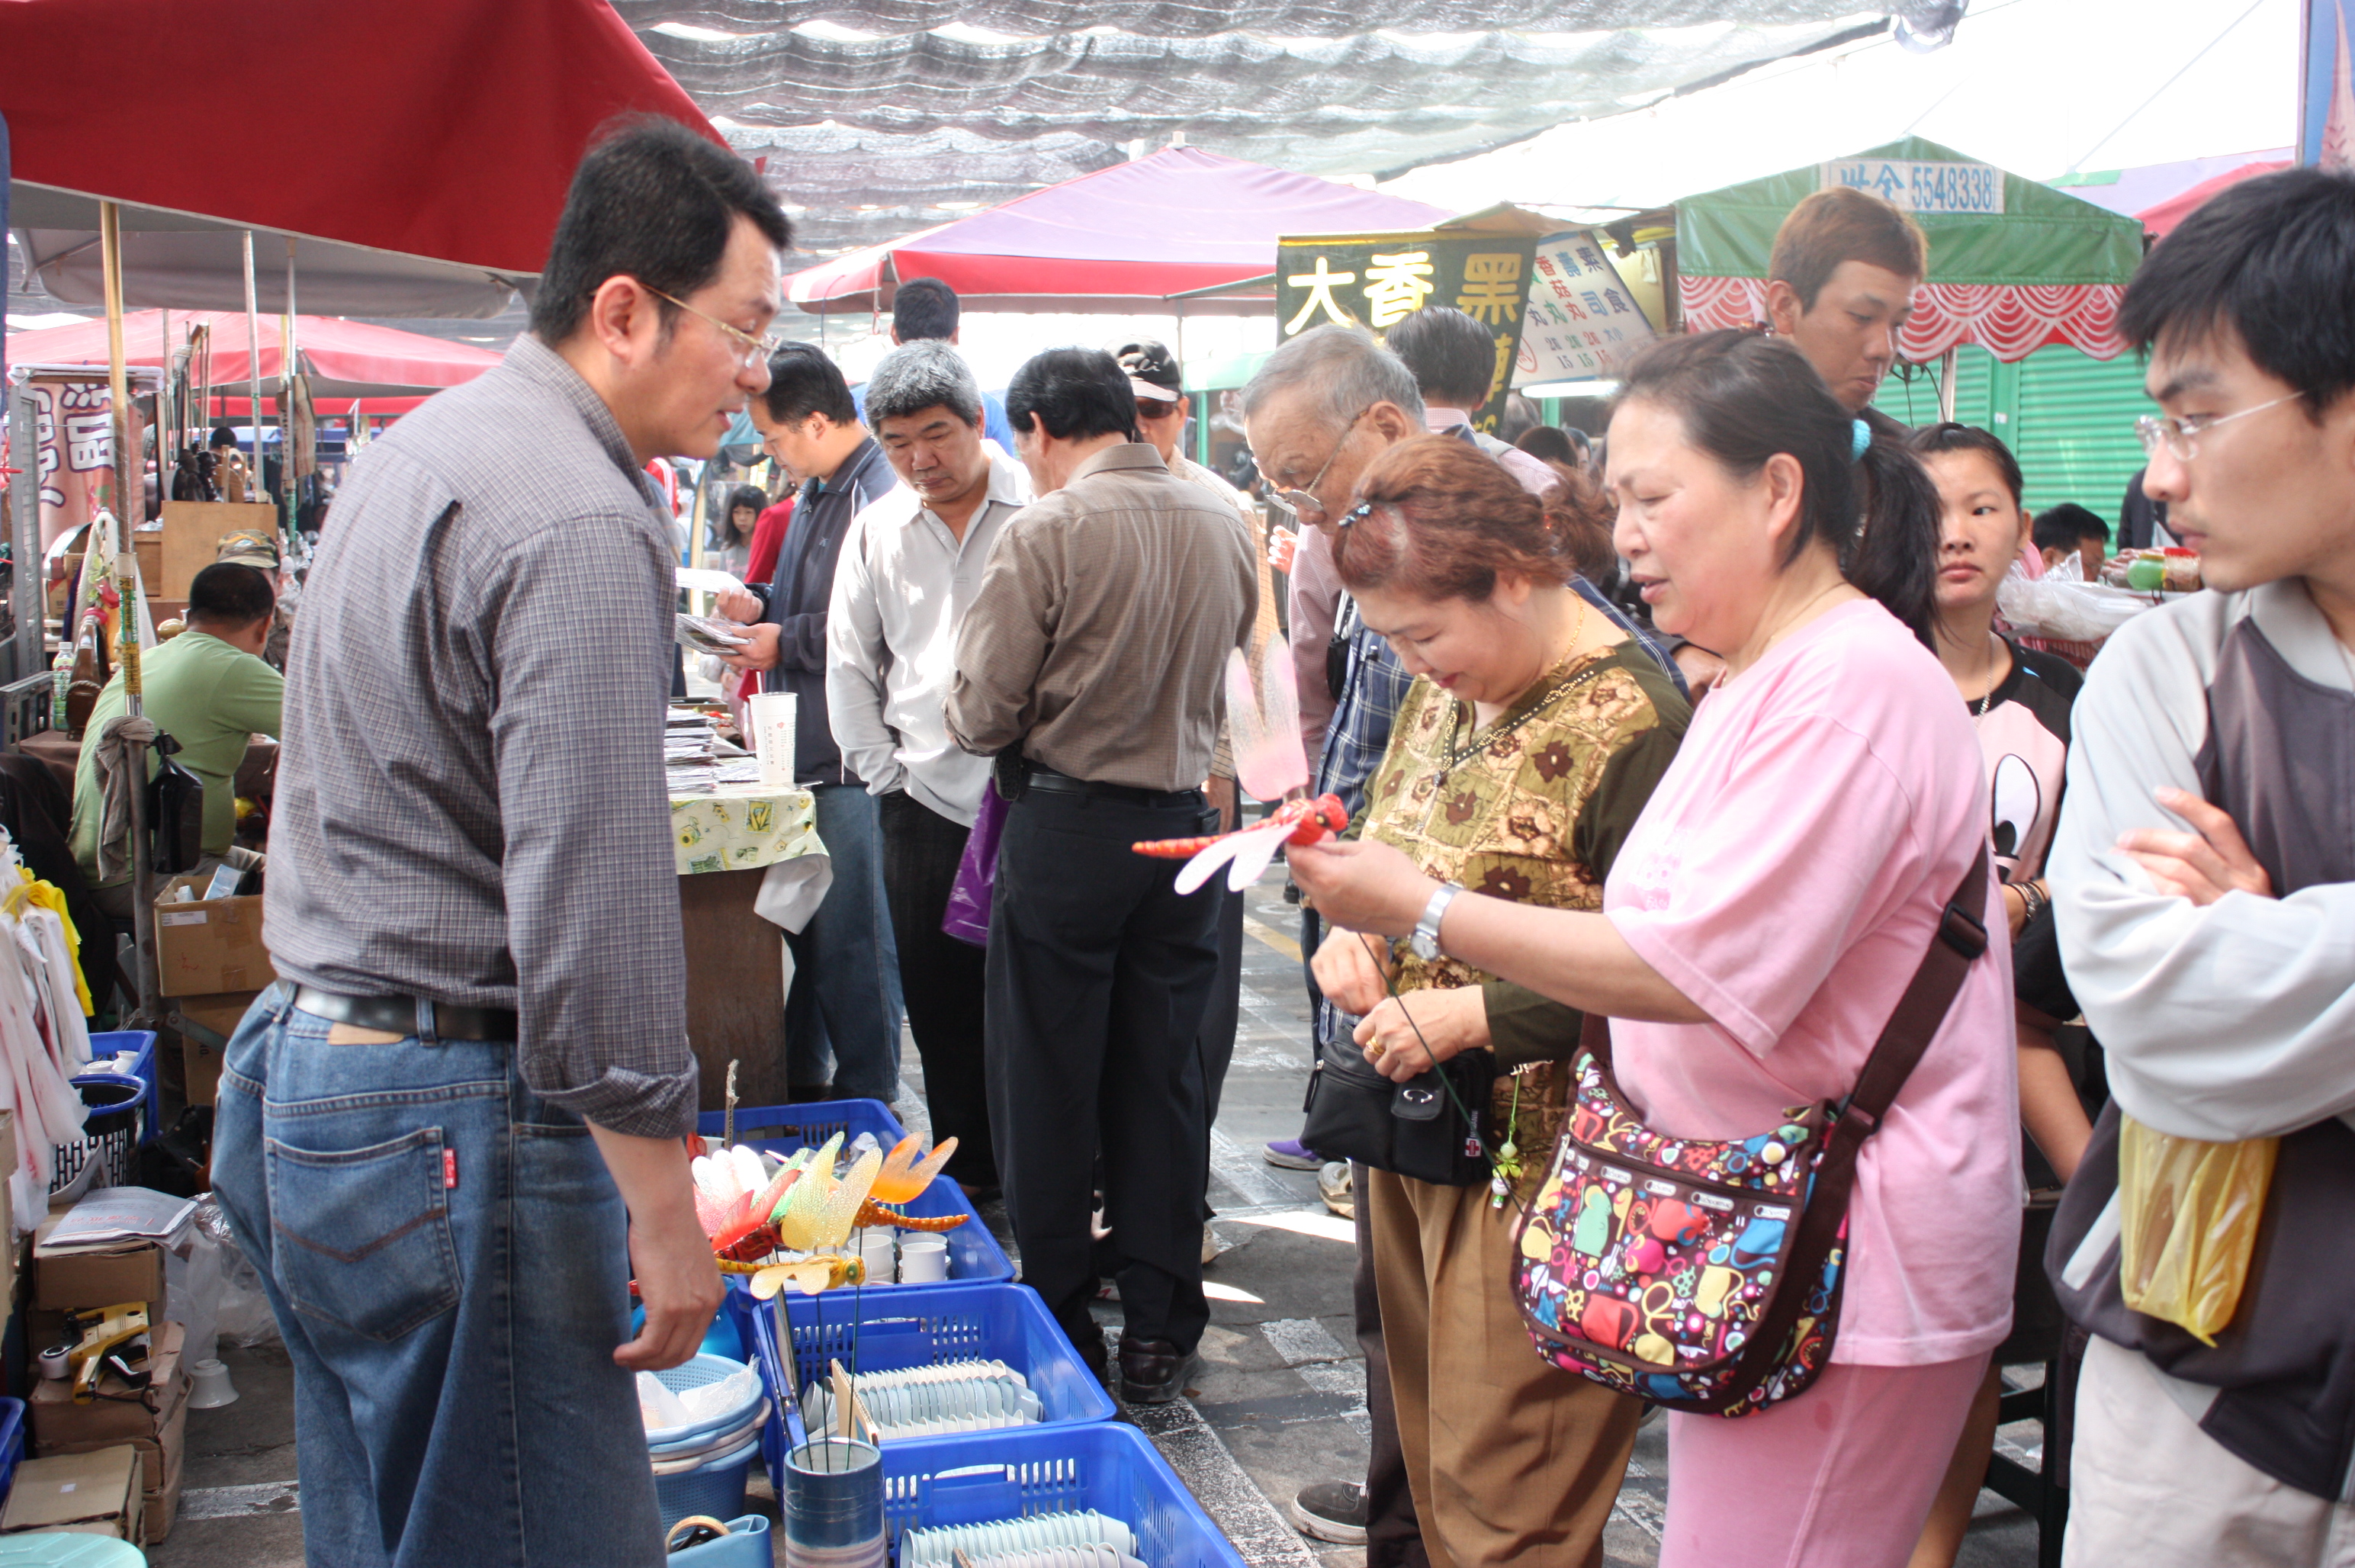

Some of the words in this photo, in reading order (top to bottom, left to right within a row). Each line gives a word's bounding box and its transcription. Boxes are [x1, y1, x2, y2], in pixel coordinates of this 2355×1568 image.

[1911, 165, 1993, 210] 5548338
[1575, 246, 1631, 313] 素食
[1557, 355, 1574, 369] 15
[1576, 352, 1595, 368] 15
